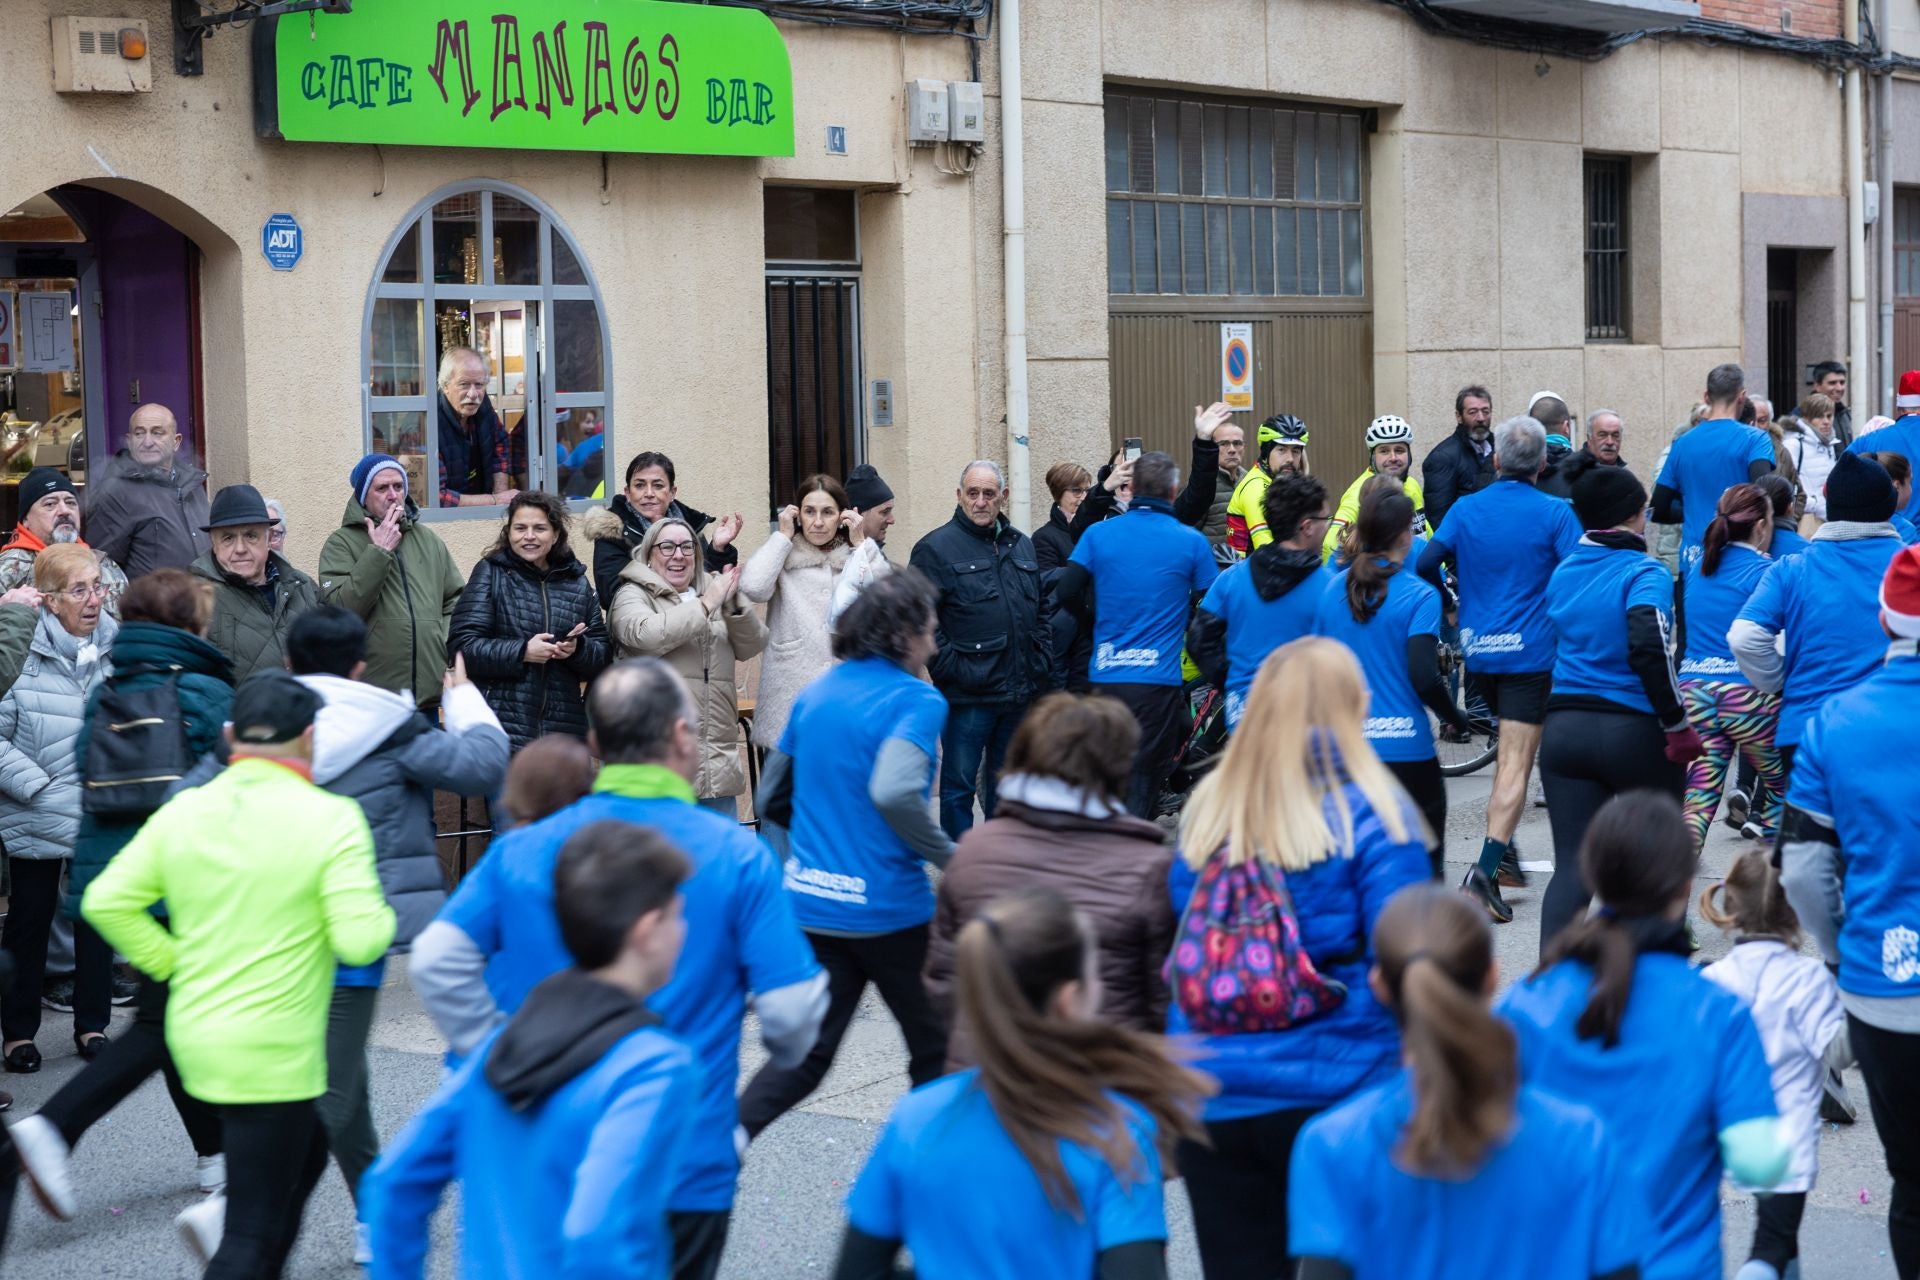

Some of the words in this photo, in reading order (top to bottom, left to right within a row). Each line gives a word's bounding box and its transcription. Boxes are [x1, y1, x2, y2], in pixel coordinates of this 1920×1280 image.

[302, 55, 412, 110] CAFE
[428, 14, 680, 126] MANAOS
[706, 78, 776, 128] BAR
[834, 131, 840, 148] 4
[269, 230, 297, 248] ADT
